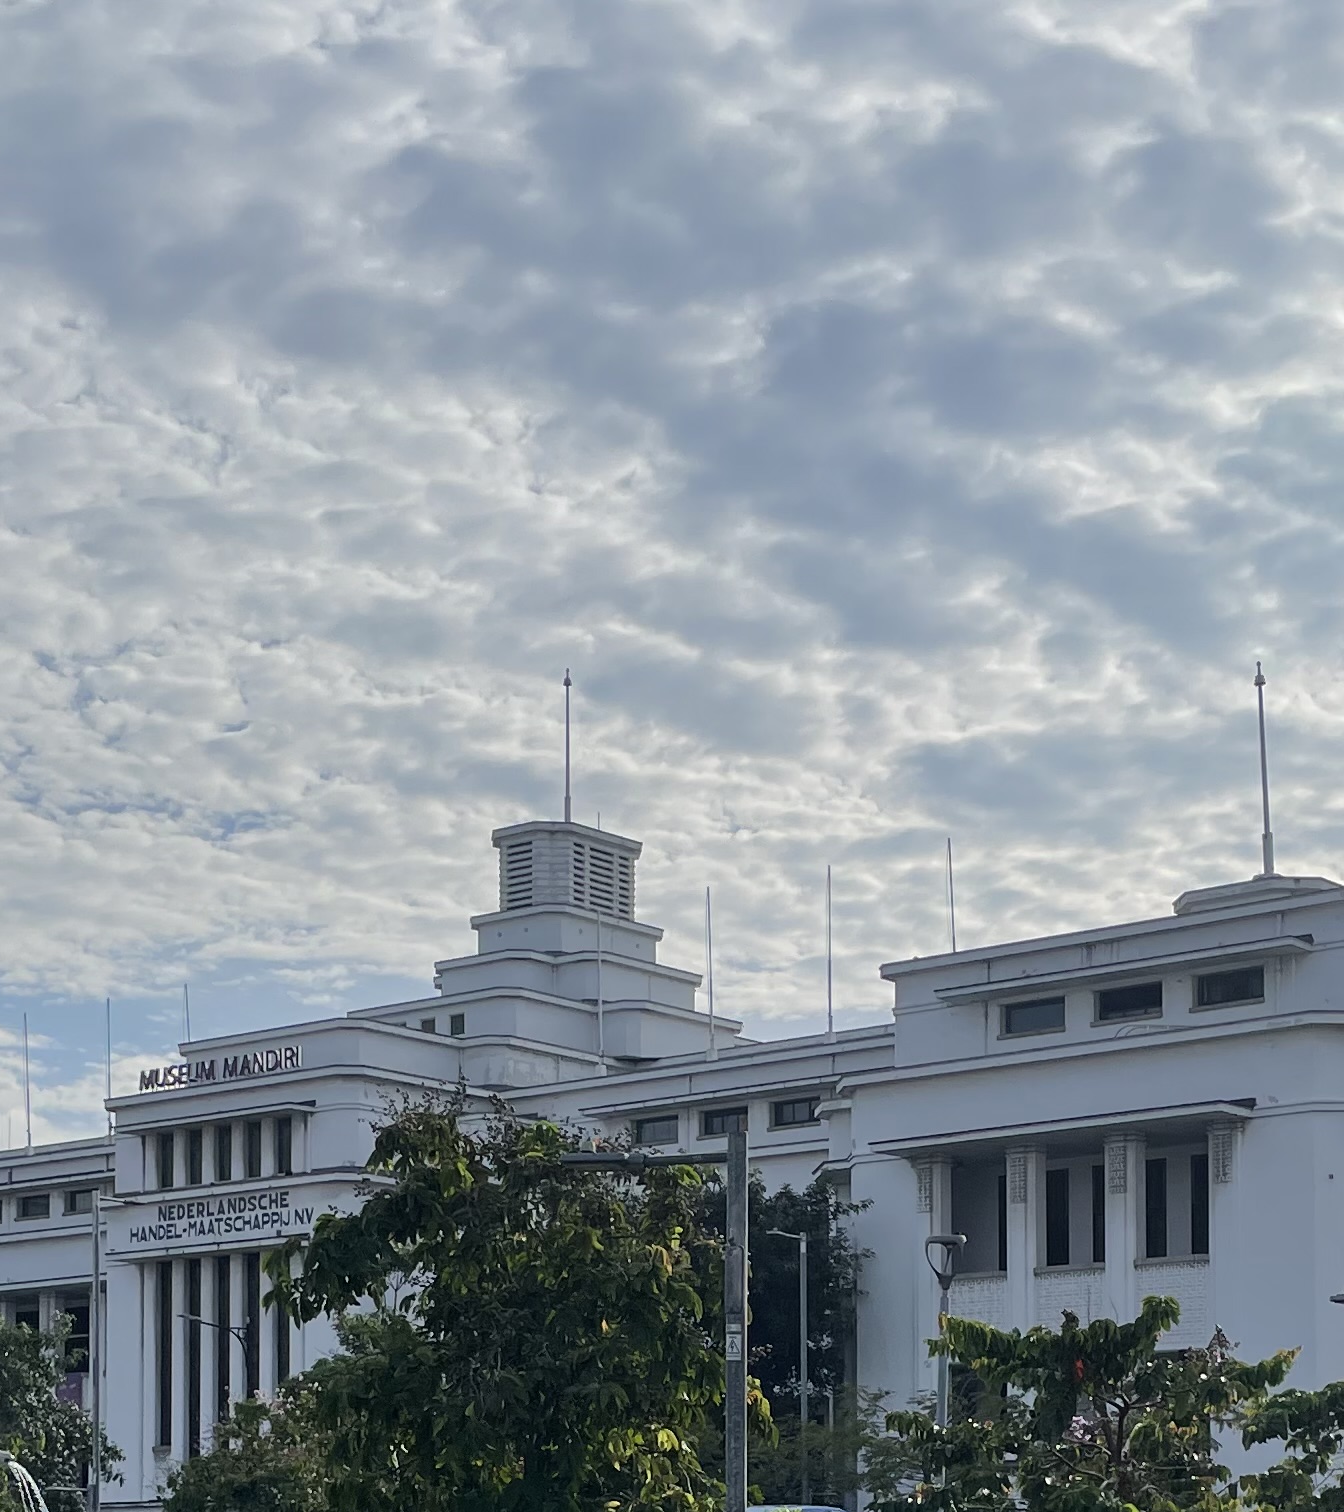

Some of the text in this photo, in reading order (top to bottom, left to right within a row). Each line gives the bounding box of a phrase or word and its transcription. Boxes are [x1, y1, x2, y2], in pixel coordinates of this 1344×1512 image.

[139, 1045, 303, 1091] MUSEUM MANDIRI
[158, 1191, 290, 1222] NEDERLANDSCHE
